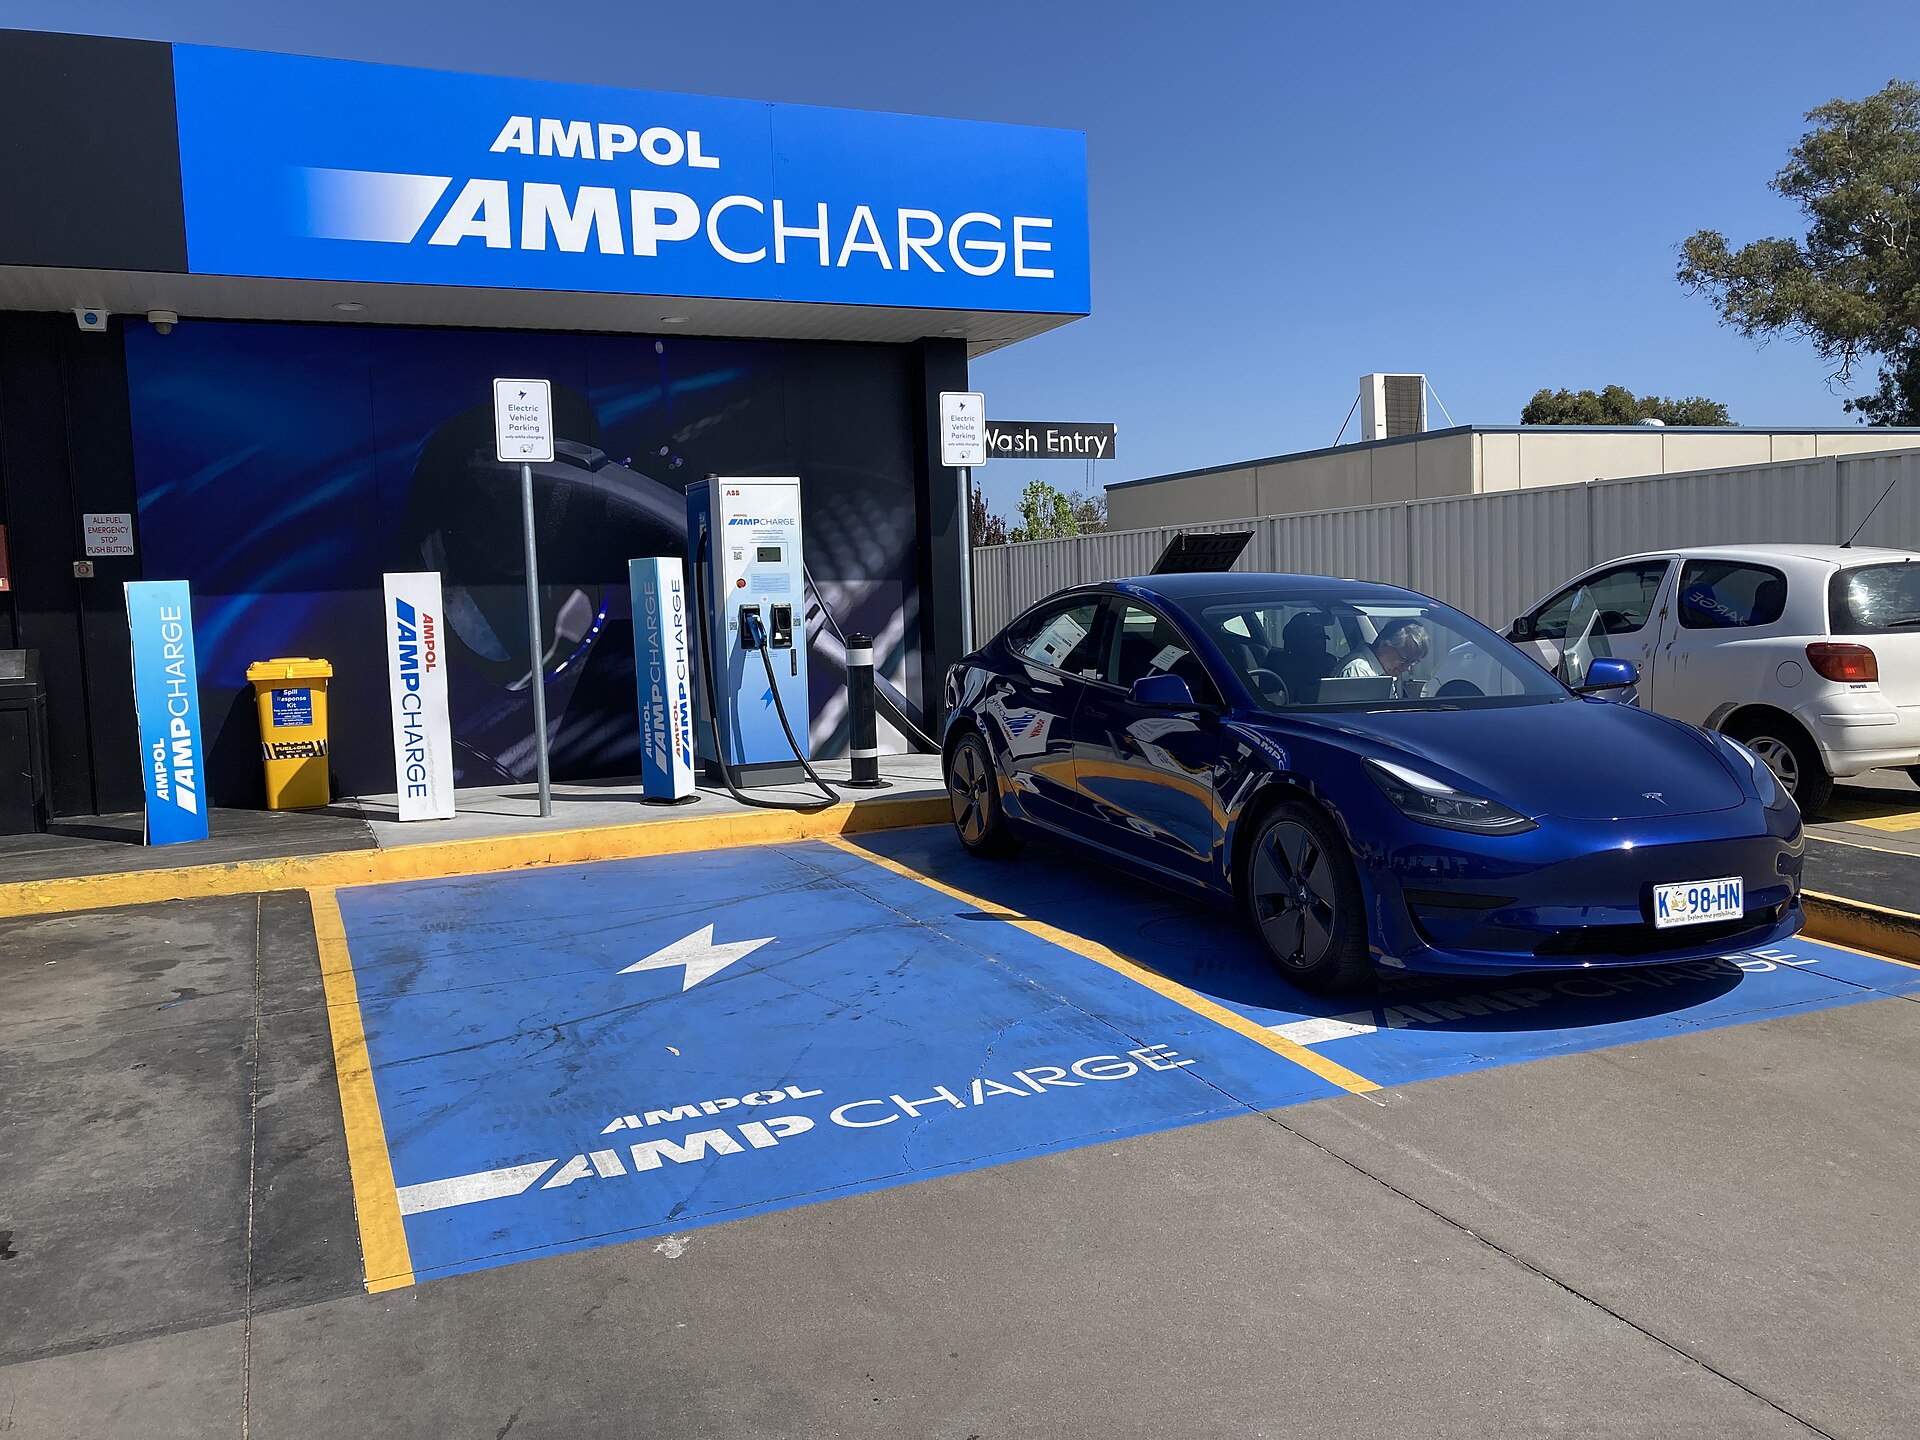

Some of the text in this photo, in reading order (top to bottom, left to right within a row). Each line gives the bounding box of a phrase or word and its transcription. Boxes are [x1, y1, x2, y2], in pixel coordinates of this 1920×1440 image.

[489, 115, 720, 169] AMPOL
[427, 178, 1055, 278] AMPCHARGE
[508, 404, 539, 412] Electric
[509, 414, 538, 422] Vehicle
[950, 414, 975, 422] Electric
[509, 424, 540, 432] Parking
[951, 433, 976, 441] Parking
[984, 429, 1108, 459] Wash Entry
[106, 516, 123, 524] FUEL
[88, 526, 129, 534] EMERGENCY
[87, 545, 133, 554] PUSH BUTTON
[422, 612, 436, 673] AMPOL
[644, 701, 653, 759] AMPOL
[673, 700, 681, 758] AMPOL
[153, 737, 170, 801] AMPOL
[600, 1085, 825, 1134] AMPOL
